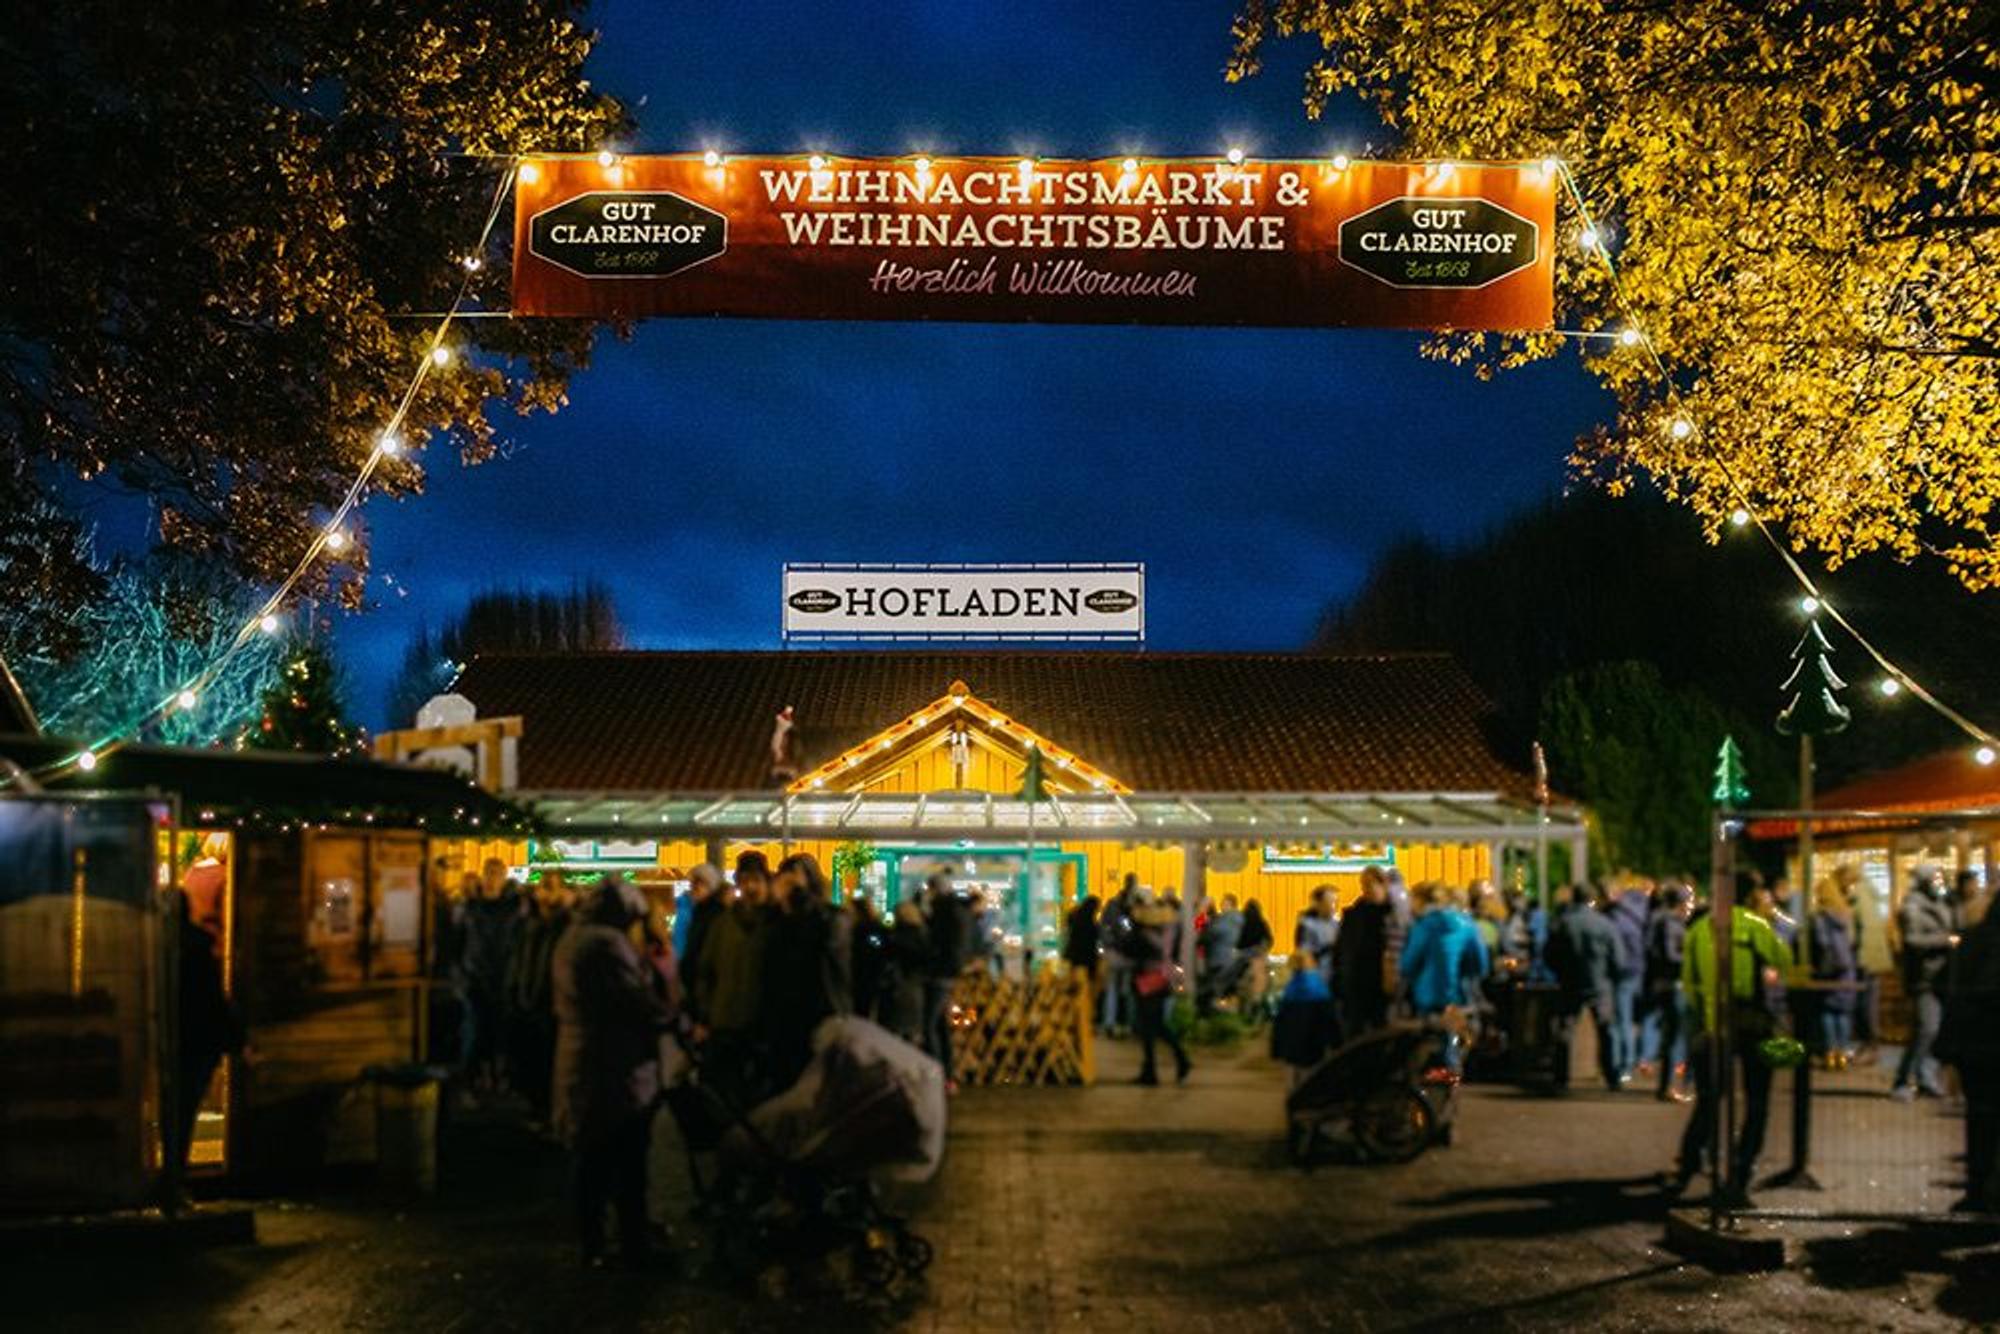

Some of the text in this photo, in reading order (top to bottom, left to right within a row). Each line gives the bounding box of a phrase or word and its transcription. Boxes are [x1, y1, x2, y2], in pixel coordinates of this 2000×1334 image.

[759, 170, 1310, 206] WEIHNACHTSMARKT &
[602, 202, 656, 221] GUT
[1412, 208, 1466, 229] GUT
[550, 225, 706, 244] CLARENHOF
[780, 208, 1286, 250] WEIHNACHTSBÄUME
[1359, 232, 1518, 253] CLARENHOF
[868, 255, 1199, 297] Herzlich Willkommen
[845, 587, 1081, 617] HOFLADEN
